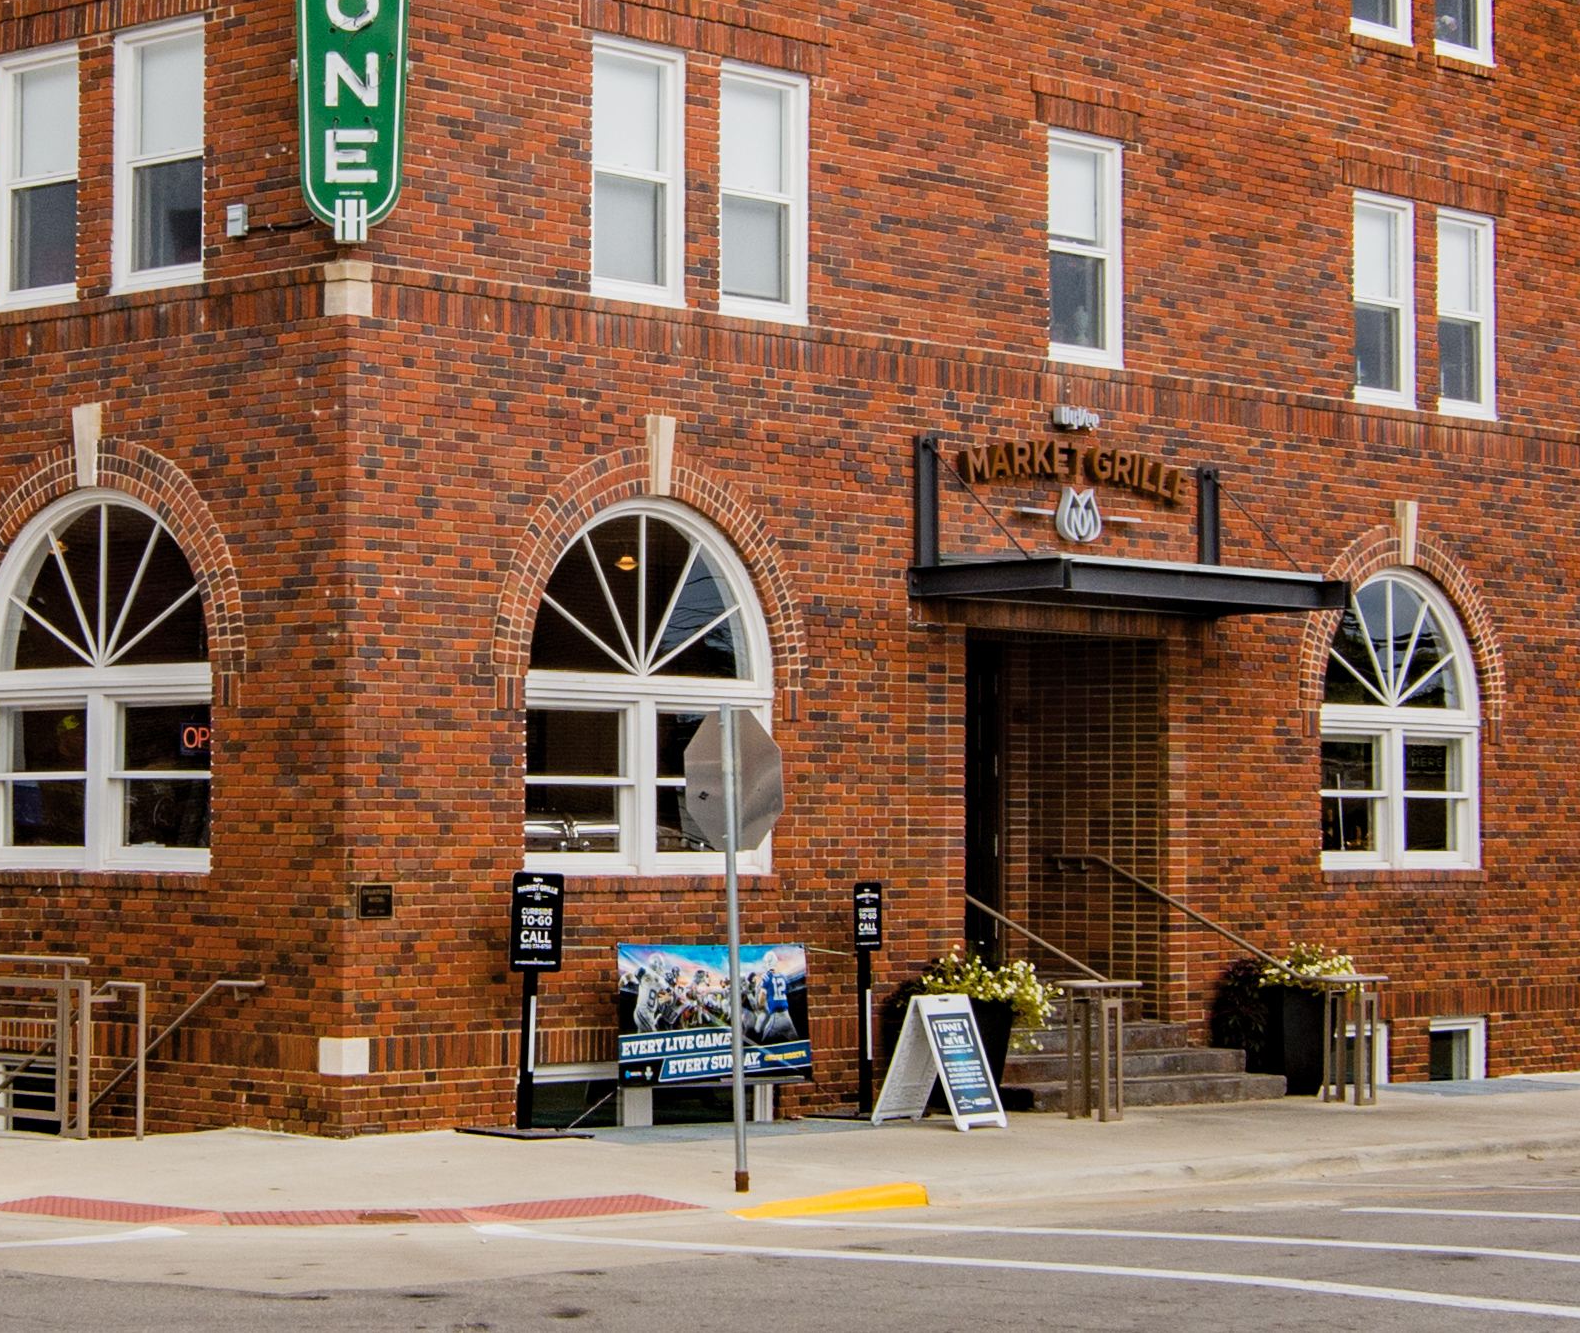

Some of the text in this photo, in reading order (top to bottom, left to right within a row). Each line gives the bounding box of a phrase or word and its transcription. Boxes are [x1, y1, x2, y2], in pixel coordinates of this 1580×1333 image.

[960, 440, 1194, 506] MARKET GRILLE
[1411, 757, 1443, 768] HERE
[521, 907, 553, 916] CURBSIDE
[521, 915, 553, 927] TO-GO
[858, 922, 878, 932] CALL
[520, 930, 552, 944] CALL
[771, 976, 787, 1001] 12
[646, 989, 657, 1009] 9
[621, 1032, 732, 1057] EVERY LIVE GAME
[668, 1057, 710, 1075] EVERY
[710, 1052, 761, 1070] SUNAY.
